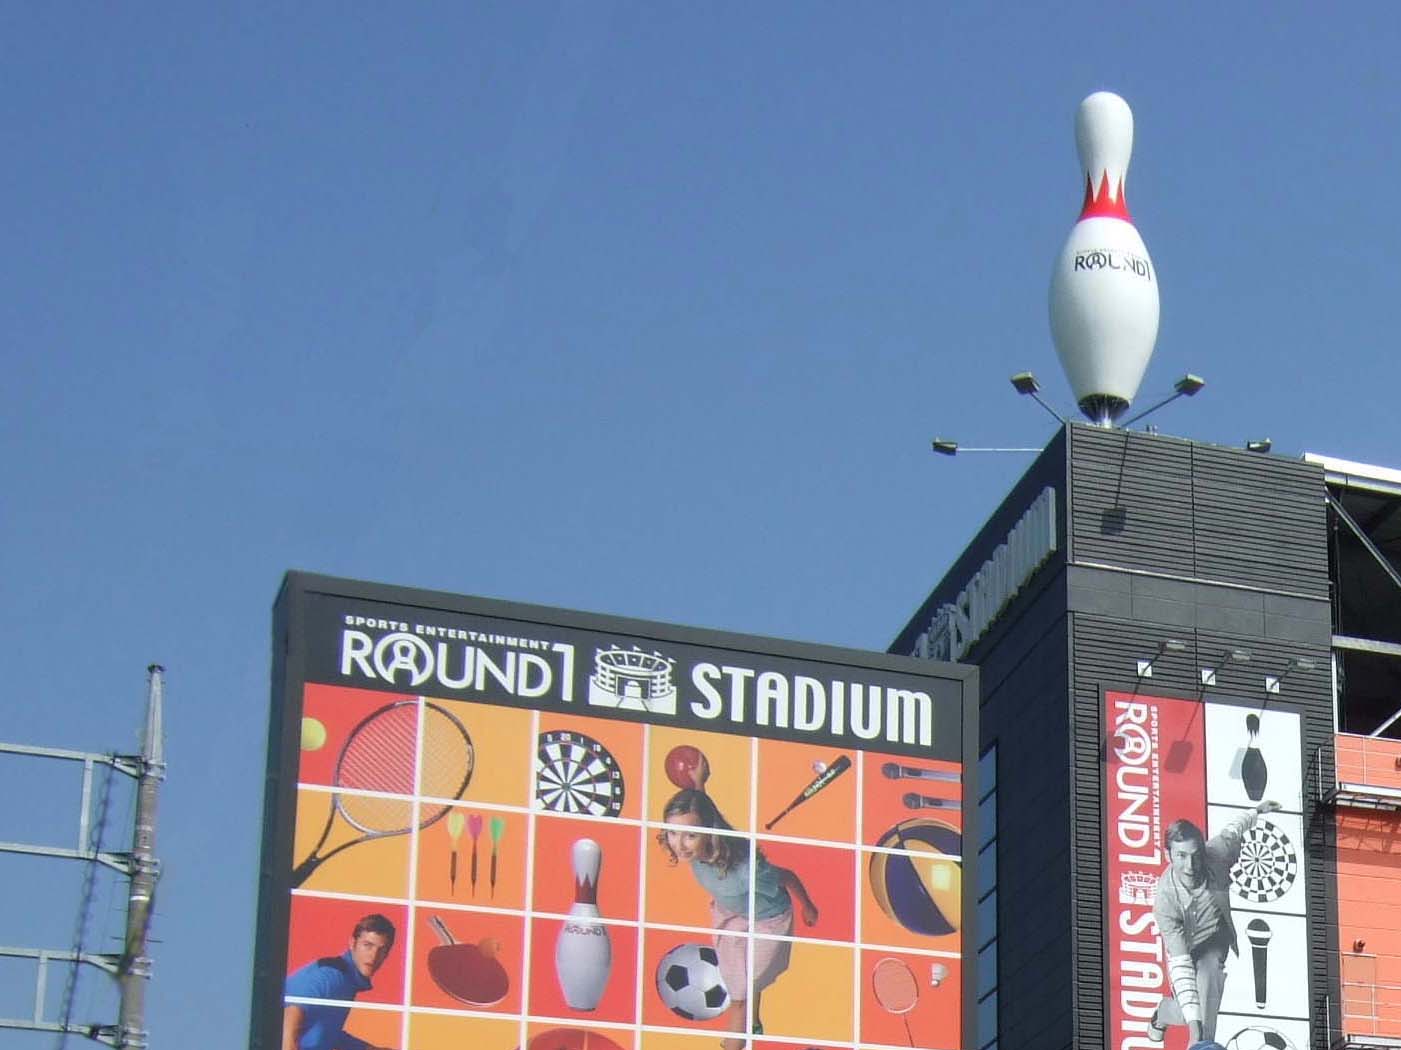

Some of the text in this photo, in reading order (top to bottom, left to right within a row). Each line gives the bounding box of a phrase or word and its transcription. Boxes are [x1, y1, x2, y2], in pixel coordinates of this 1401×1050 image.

[345, 615, 550, 650] SPORTS ENTERTAINMENT
[690, 663, 932, 747] STADIUM
